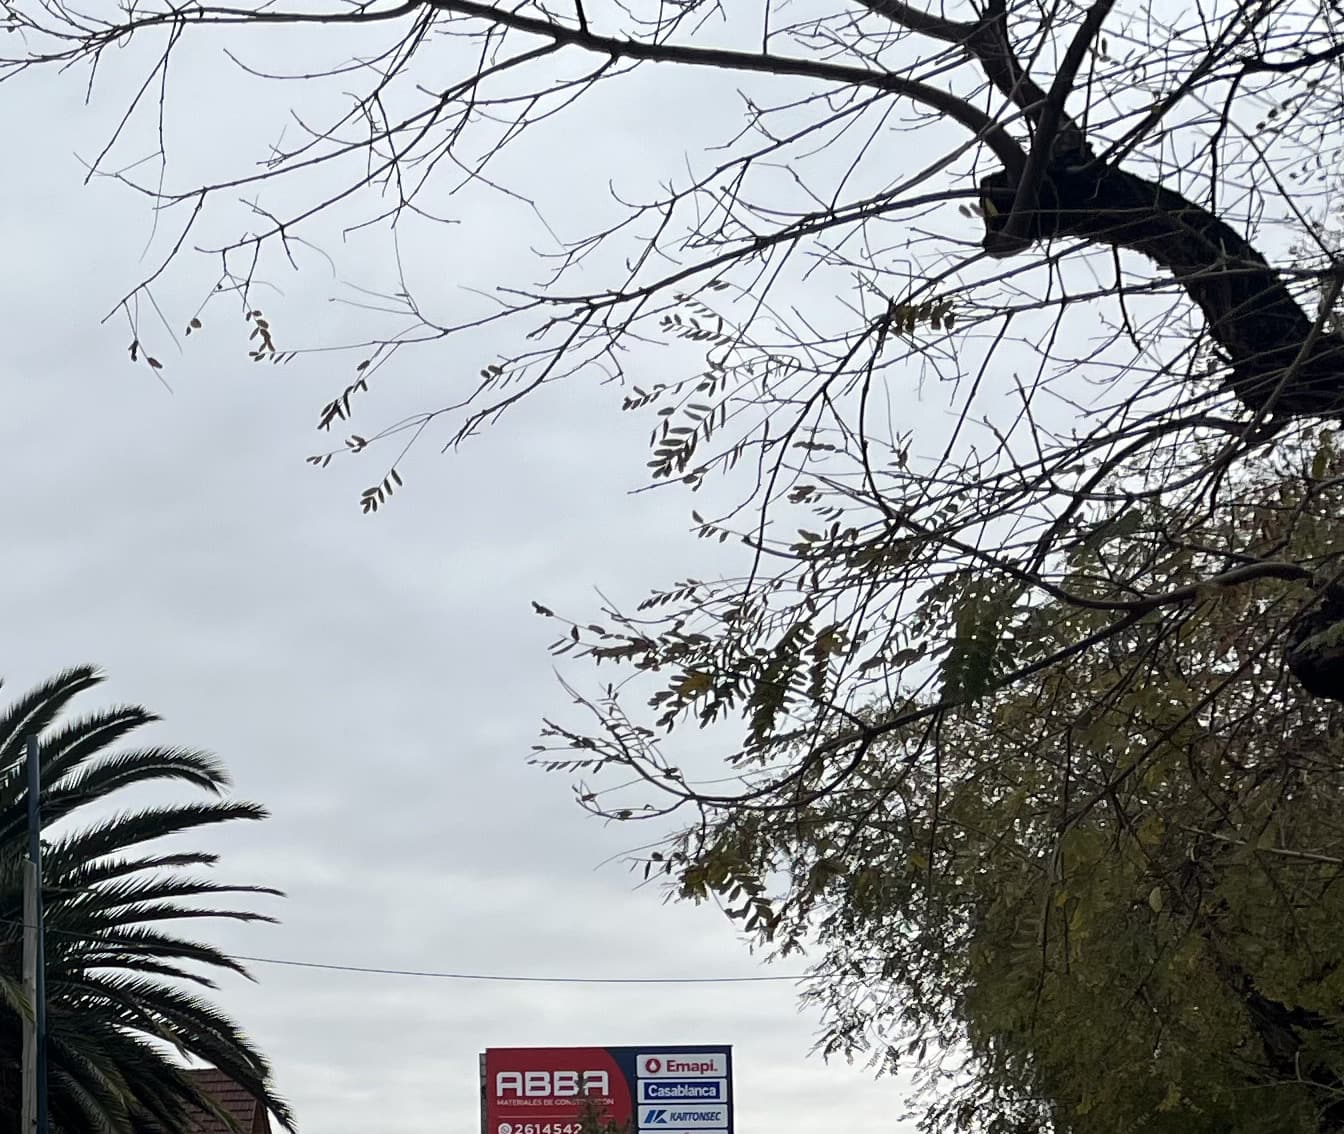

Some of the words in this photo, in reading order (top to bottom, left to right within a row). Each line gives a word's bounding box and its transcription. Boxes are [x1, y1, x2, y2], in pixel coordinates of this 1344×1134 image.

[496, 1070, 609, 1097] ABBA
[648, 1084, 717, 1097] Casablanca
[496, 1098, 542, 1106] MATERIALES
